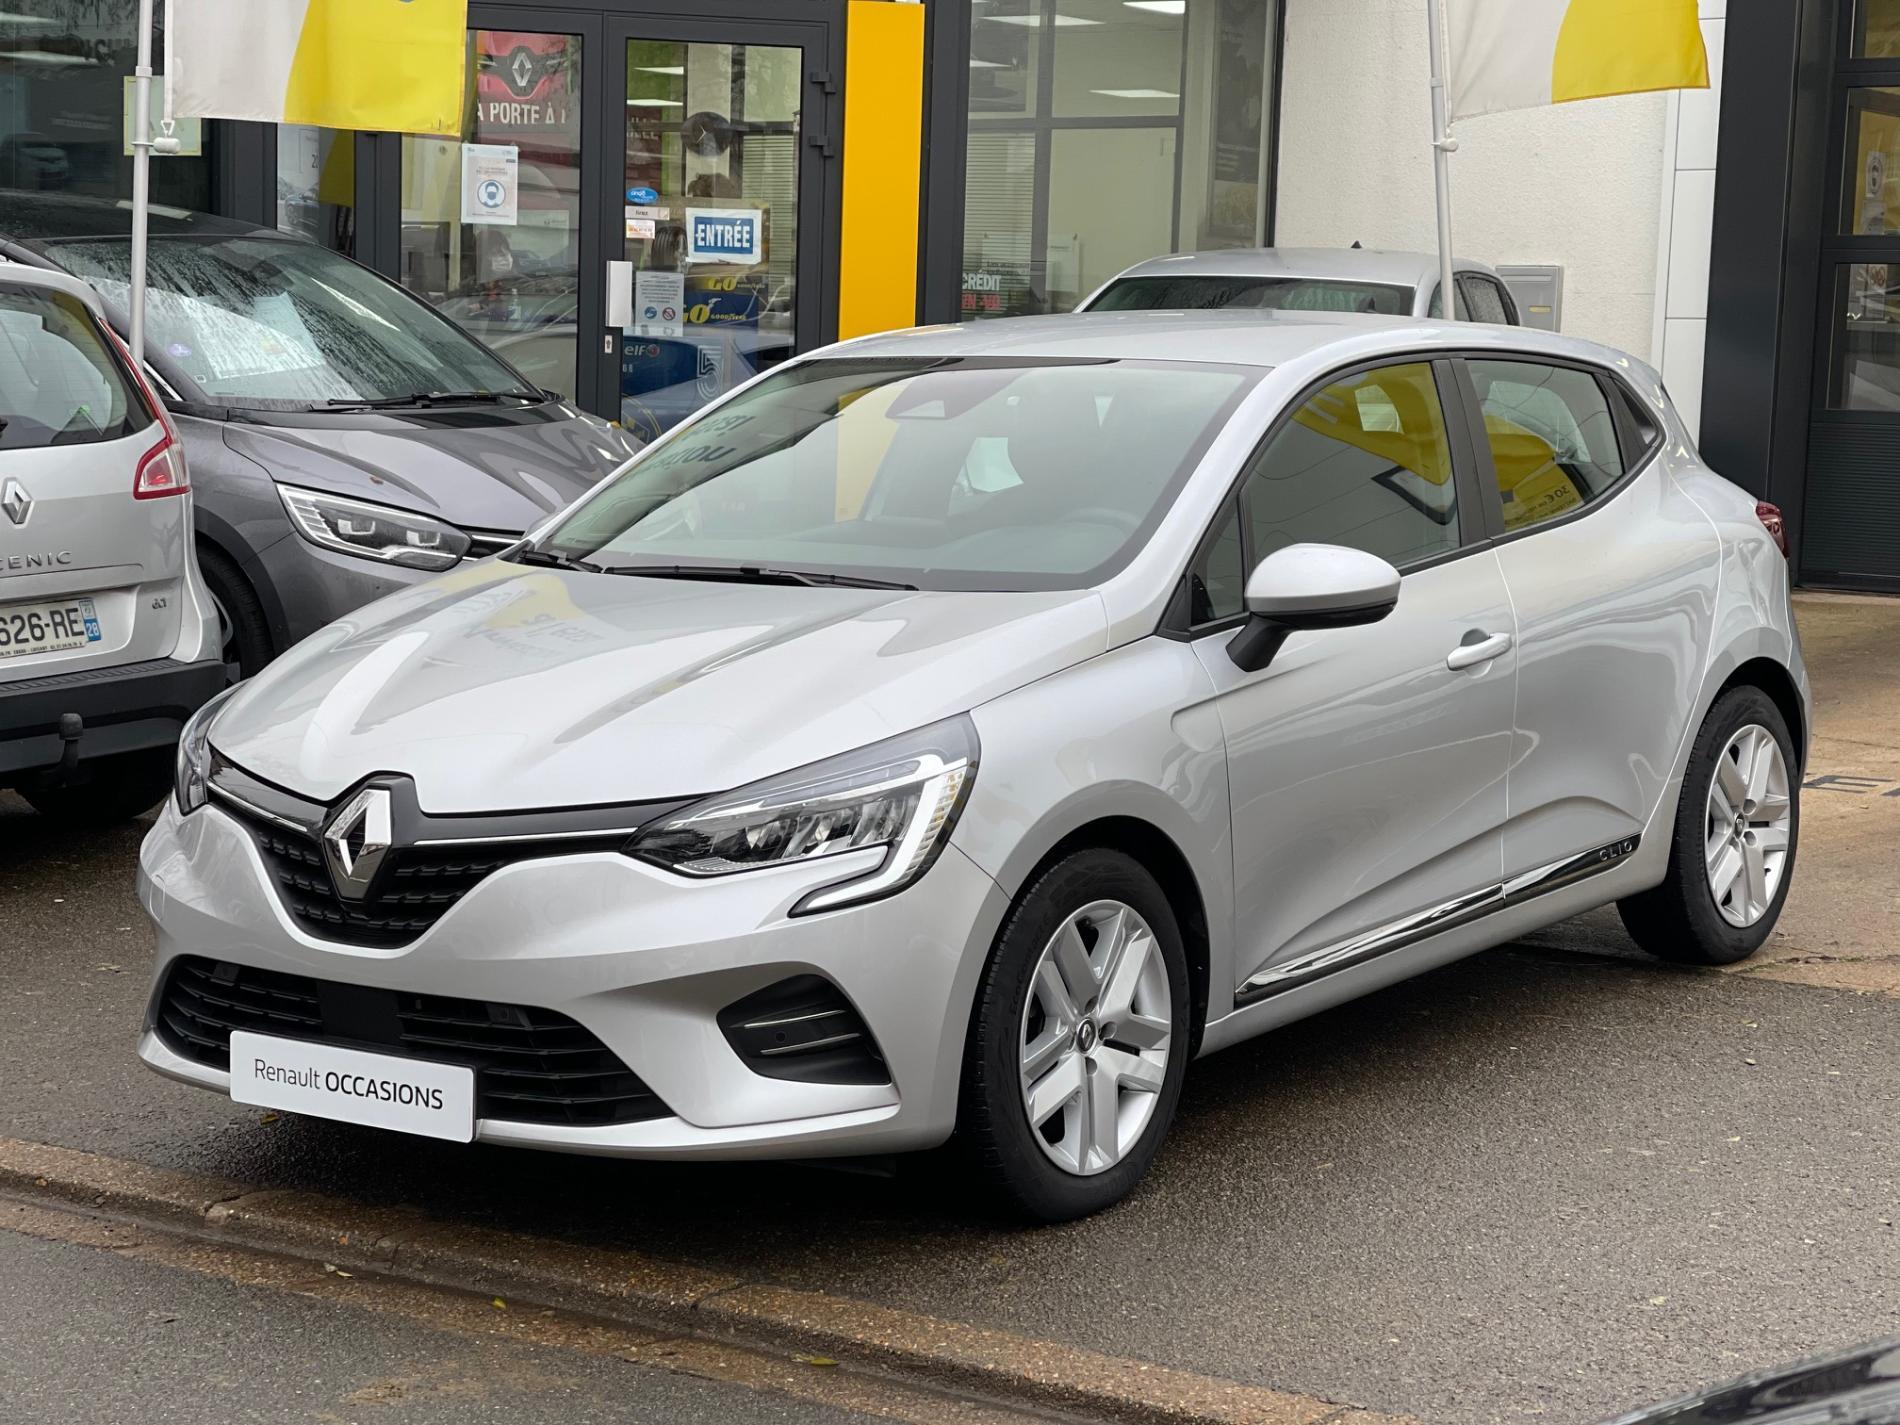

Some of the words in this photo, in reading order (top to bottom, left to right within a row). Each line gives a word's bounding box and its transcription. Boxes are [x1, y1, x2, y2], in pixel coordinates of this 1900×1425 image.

[489, 102, 540, 125] PORTE
[696, 220, 751, 248] ENTRÉE
[624, 344, 647, 356] elf
[0, 551, 72, 571] ENIC
[86, 622, 100, 637] 28
[1599, 841, 1633, 861] CLIO
[254, 1058, 321, 1090] Renault
[325, 1071, 443, 1110] OCCASIONS
